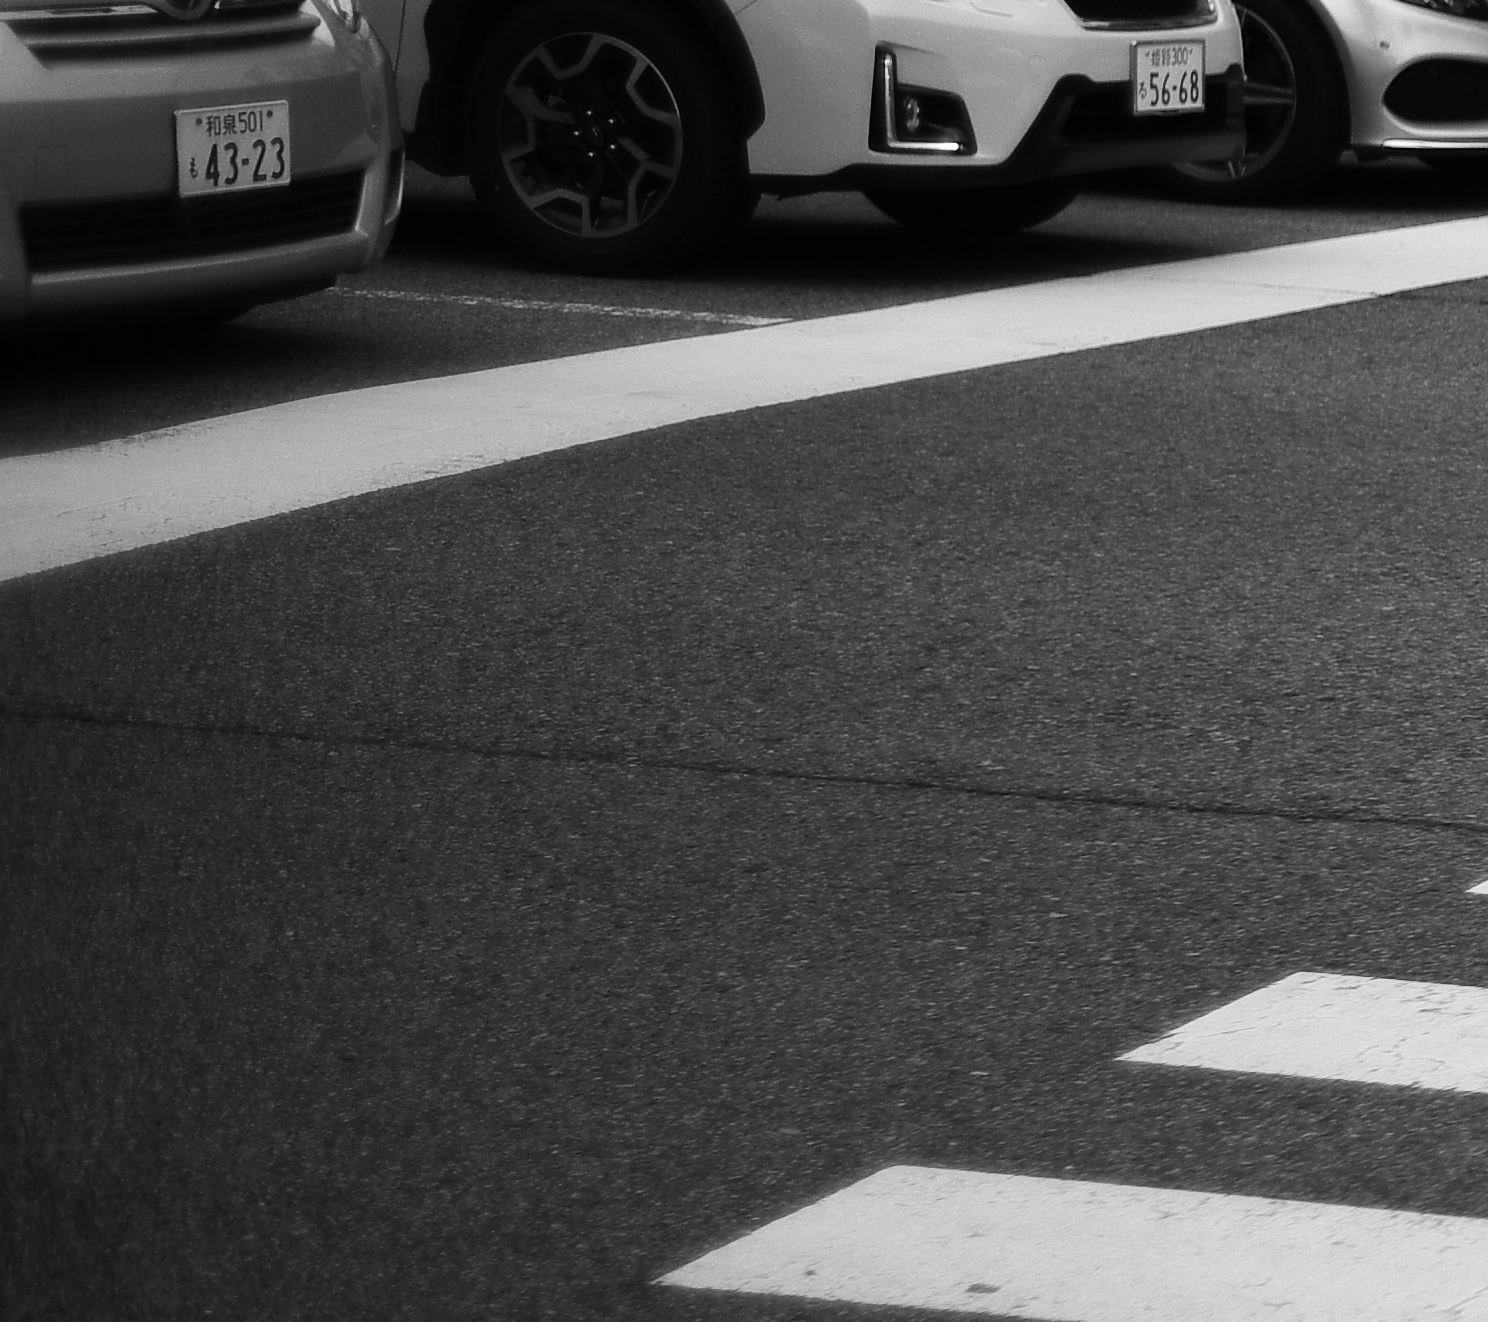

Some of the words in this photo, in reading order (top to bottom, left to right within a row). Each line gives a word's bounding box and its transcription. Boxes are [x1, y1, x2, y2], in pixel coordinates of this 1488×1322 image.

[1149, 69, 1200, 107] 56-68
[206, 111, 263, 137] 和泉501
[205, 137, 285, 187] 43-23
